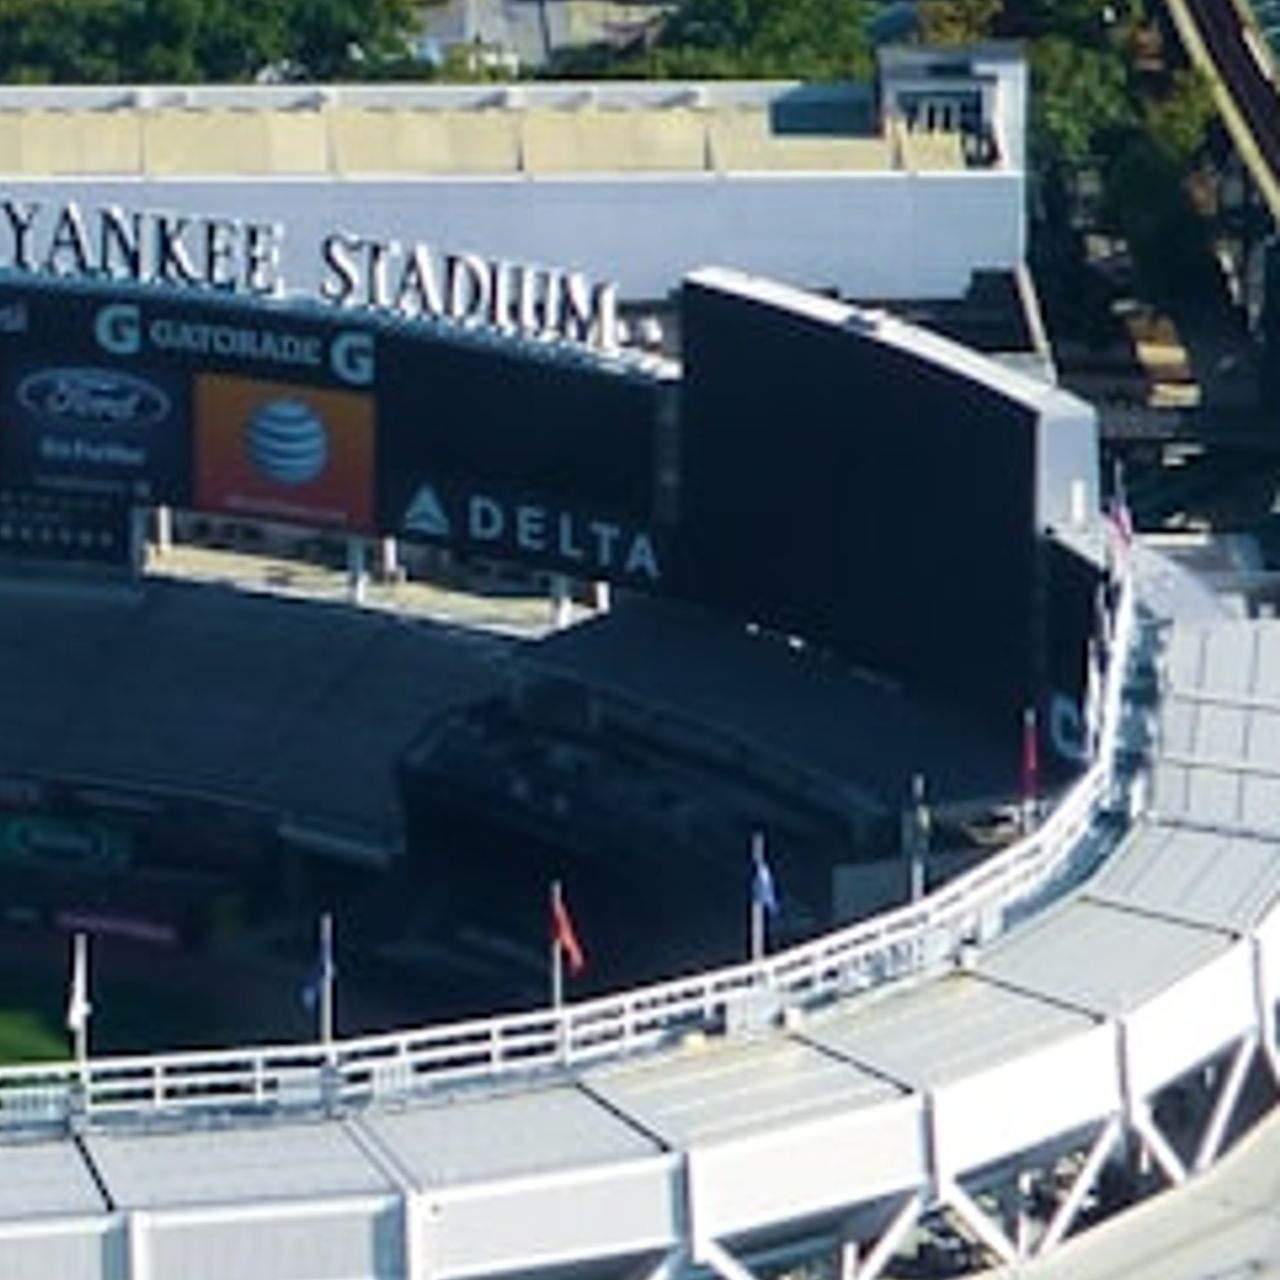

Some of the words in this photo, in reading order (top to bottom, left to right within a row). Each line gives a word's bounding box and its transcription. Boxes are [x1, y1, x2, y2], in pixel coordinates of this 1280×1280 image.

[2, 201, 284, 297] YANKEE
[320, 234, 619, 351] STADIUM
[95, 303, 139, 355] G
[149, 322, 322, 365] GATORADE
[329, 333, 376, 384] G
[470, 496, 661, 578] DELTA
